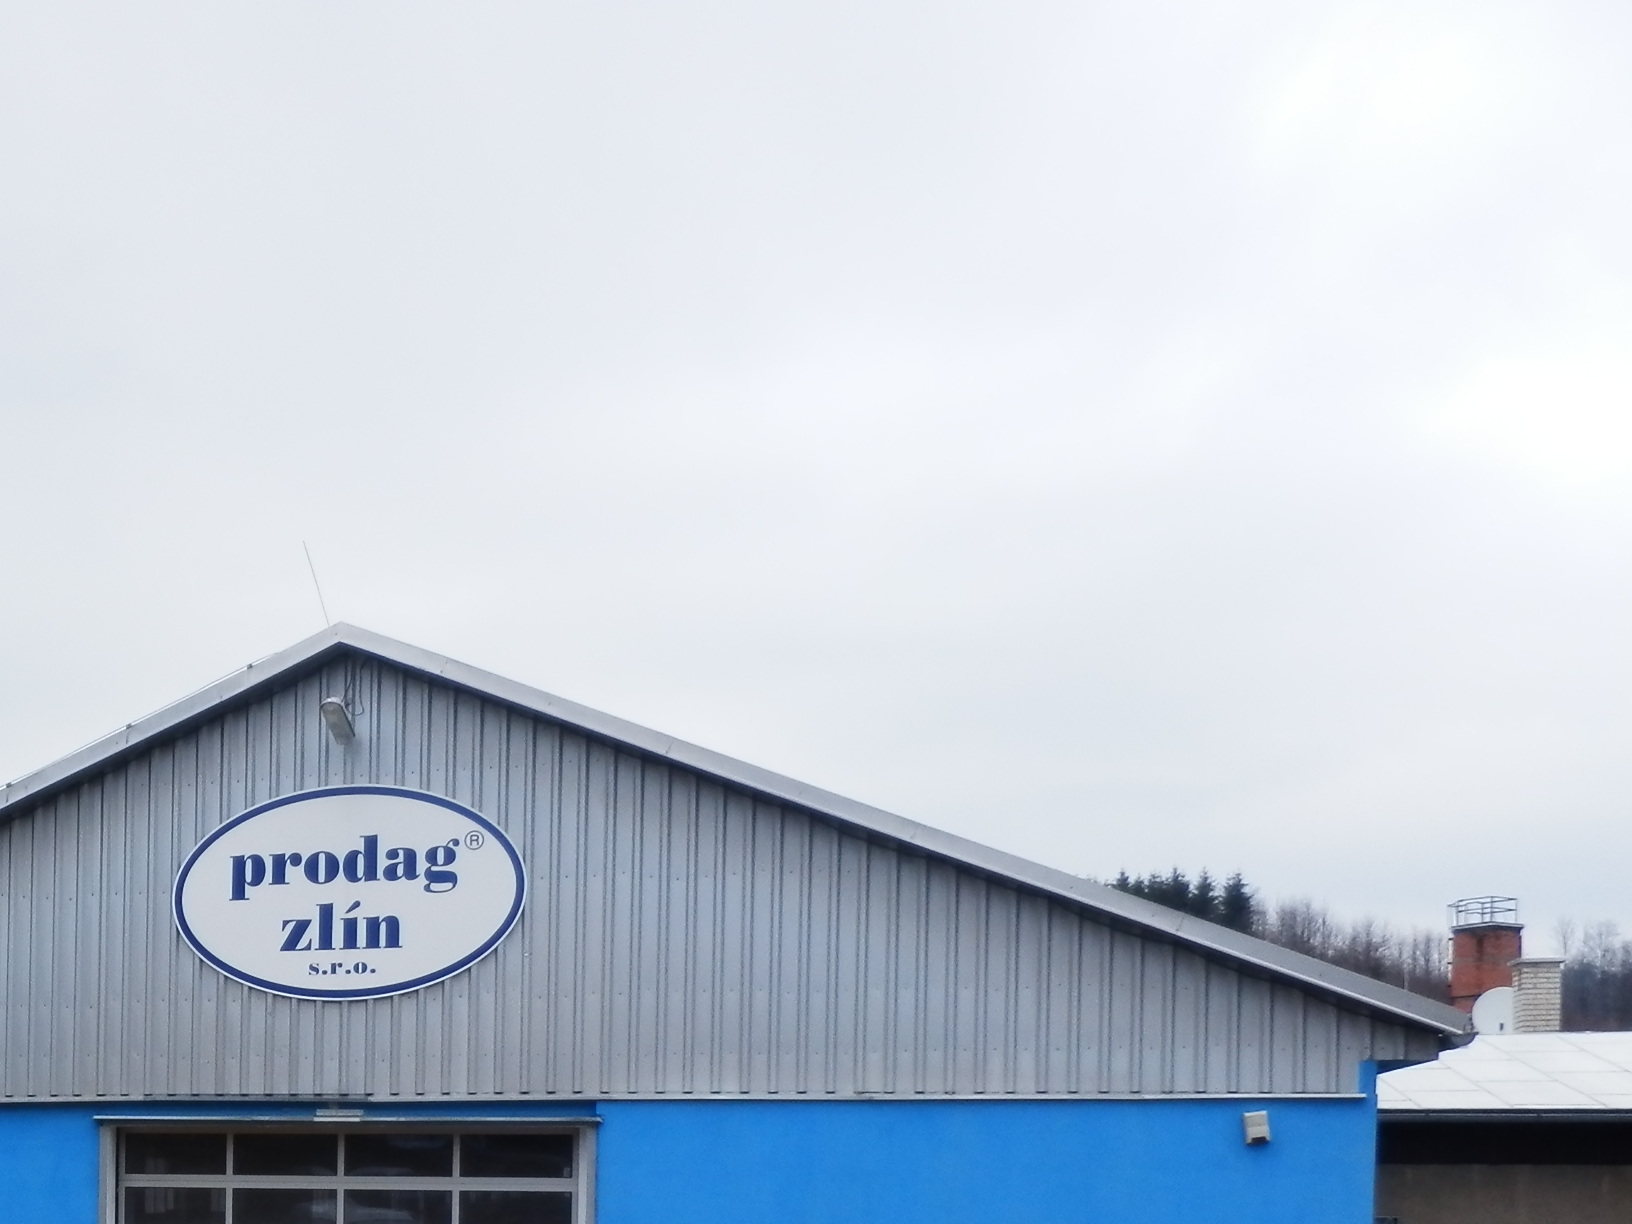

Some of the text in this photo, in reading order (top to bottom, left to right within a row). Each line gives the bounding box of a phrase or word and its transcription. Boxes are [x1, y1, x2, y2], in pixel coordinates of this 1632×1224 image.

[229, 834, 460, 901] prodag
[279, 900, 403, 952] zlín
[308, 961, 376, 976] s.r.o.
